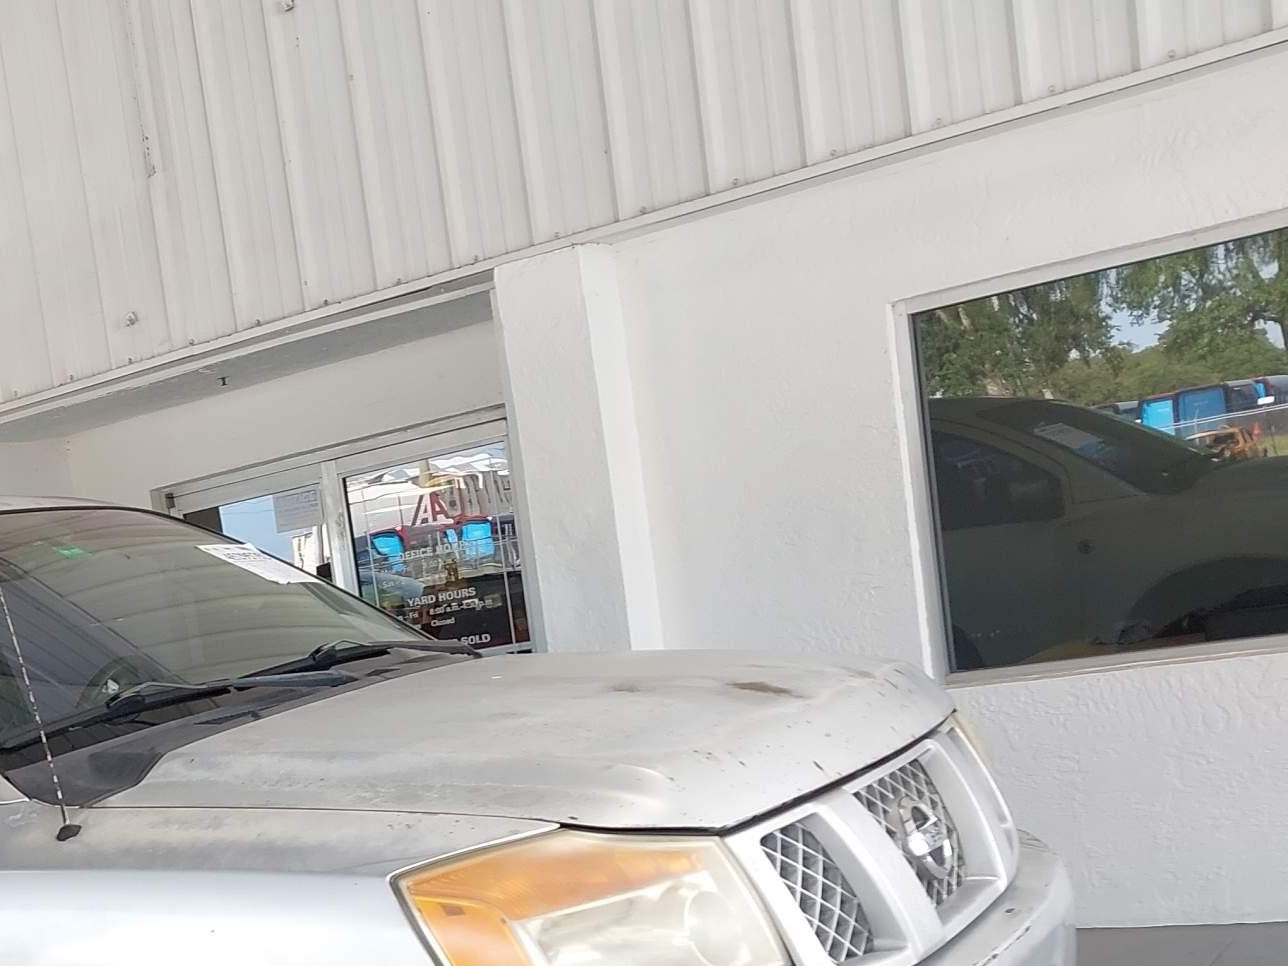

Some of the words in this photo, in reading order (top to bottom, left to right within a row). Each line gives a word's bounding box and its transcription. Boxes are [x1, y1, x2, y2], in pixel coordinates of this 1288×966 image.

[408, 595, 436, 608] YARD
[438, 587, 476, 602] HOURS
[461, 633, 491, 645] SOLD
